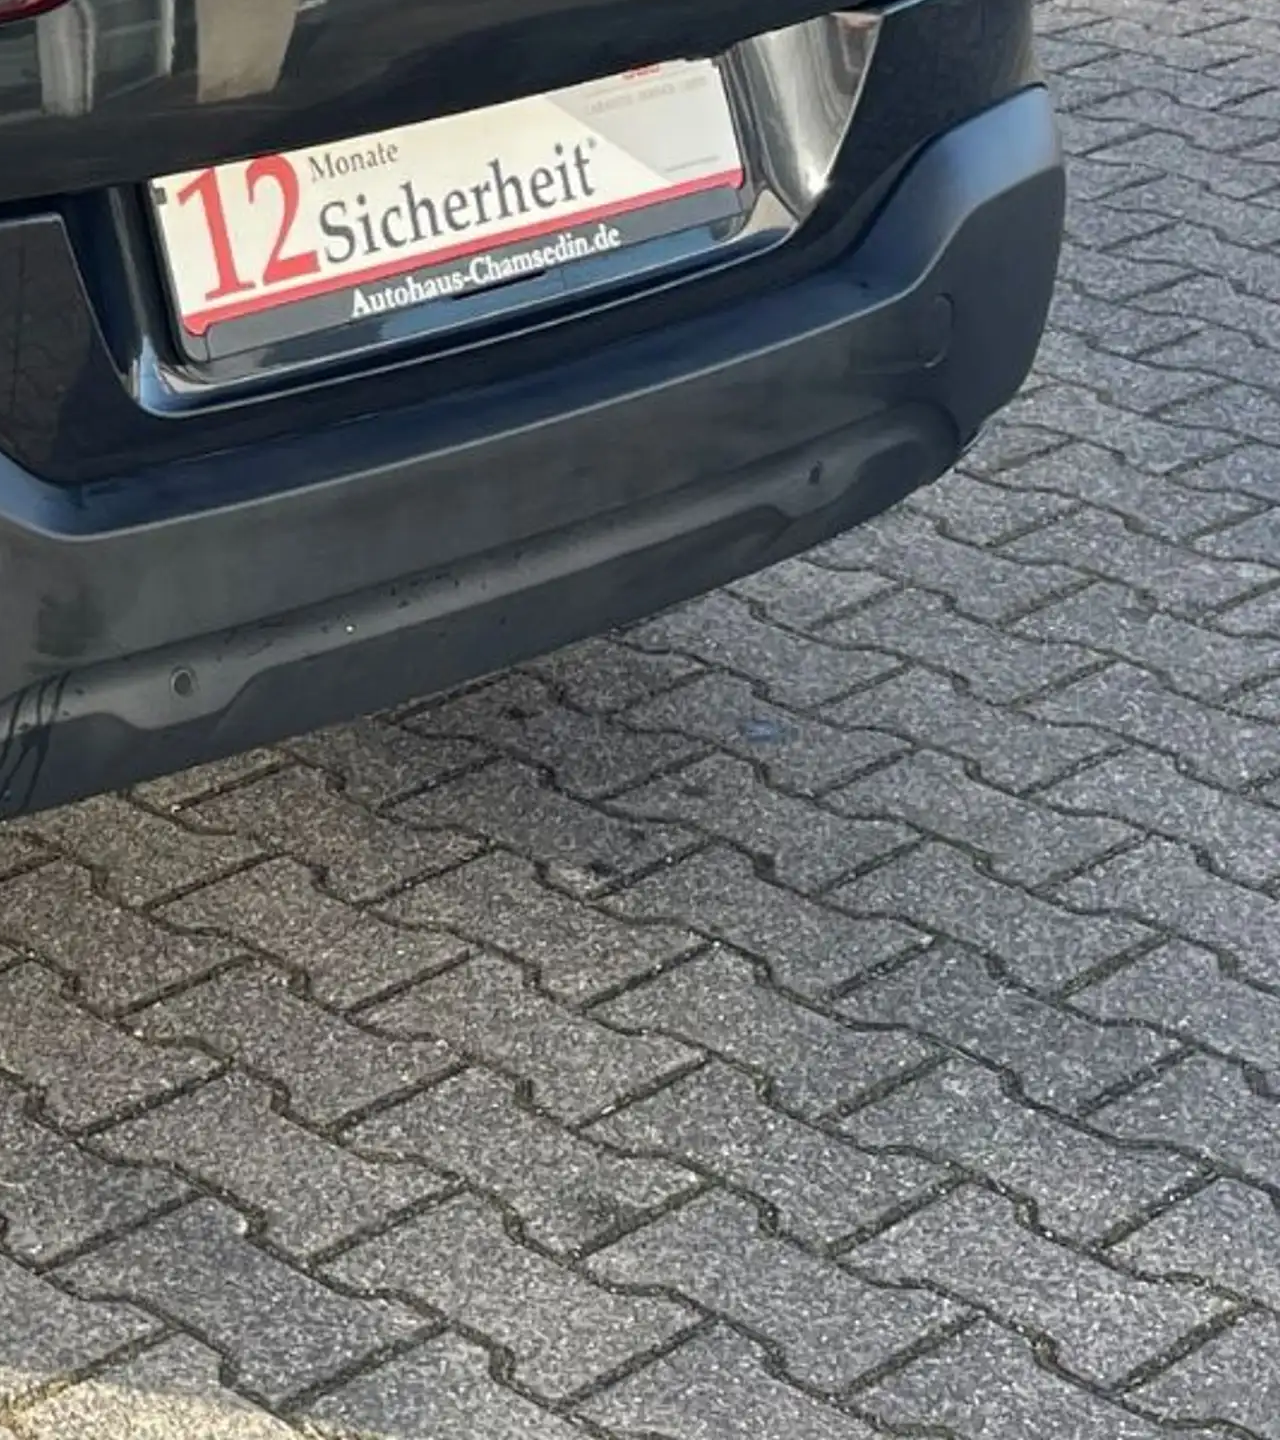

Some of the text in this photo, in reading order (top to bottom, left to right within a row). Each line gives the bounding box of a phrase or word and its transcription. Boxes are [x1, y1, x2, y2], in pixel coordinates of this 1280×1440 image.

[308, 141, 400, 183] Monate
[177, 152, 321, 302] 12
[351, 223, 622, 321] Autohaus-Chamsedin.de
